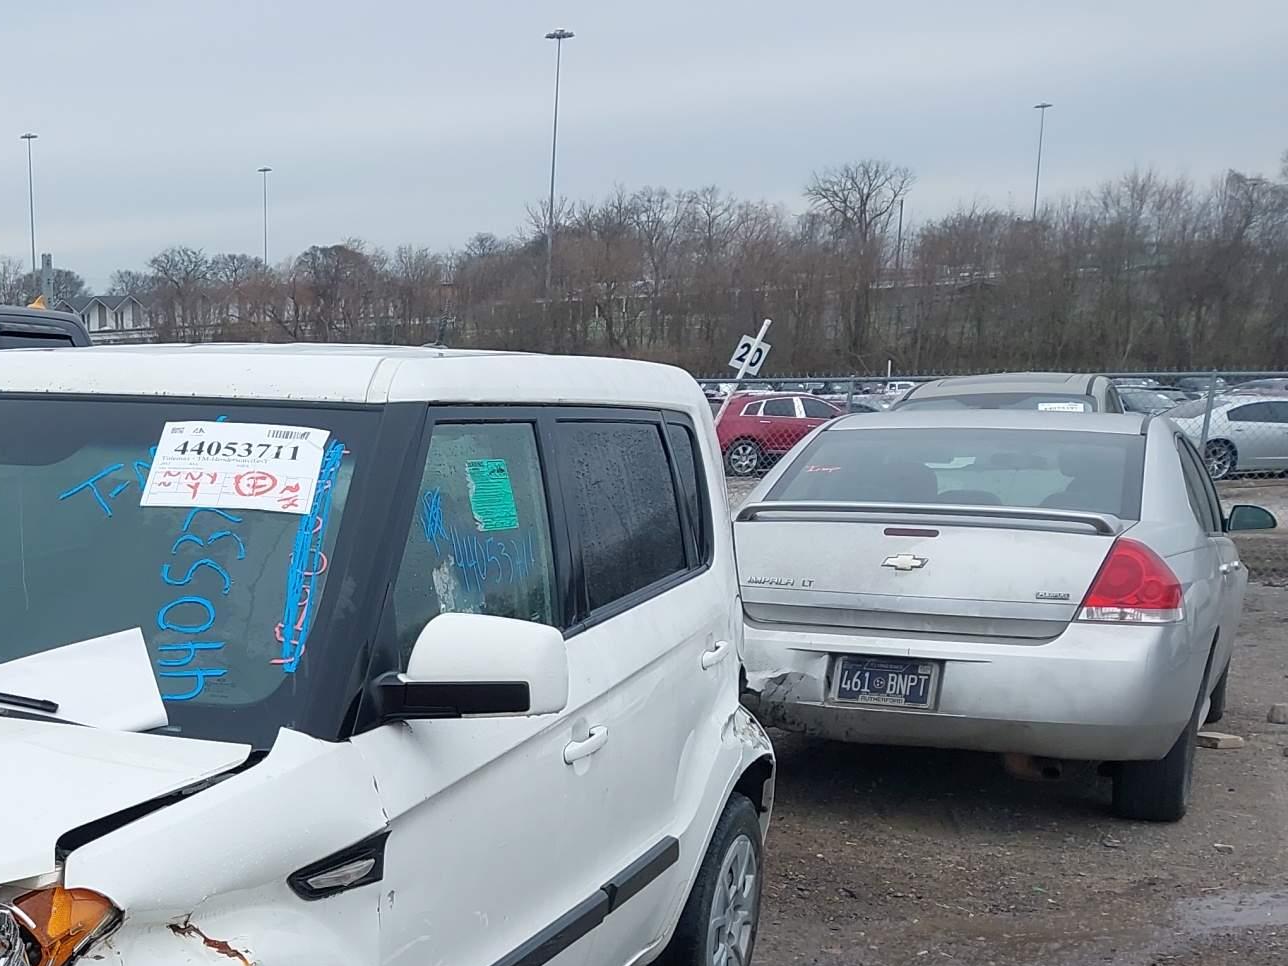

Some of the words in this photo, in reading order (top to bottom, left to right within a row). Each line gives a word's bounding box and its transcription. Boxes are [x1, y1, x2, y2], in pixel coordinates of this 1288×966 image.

[735, 343, 763, 367] 20
[174, 440, 300, 460] 44053711
[747, 576, 795, 587] IMPALA
[801, 579, 815, 588] LT
[157, 506, 246, 701] 440537
[841, 670, 871, 692] 461
[886, 673, 929, 697] BNPT
